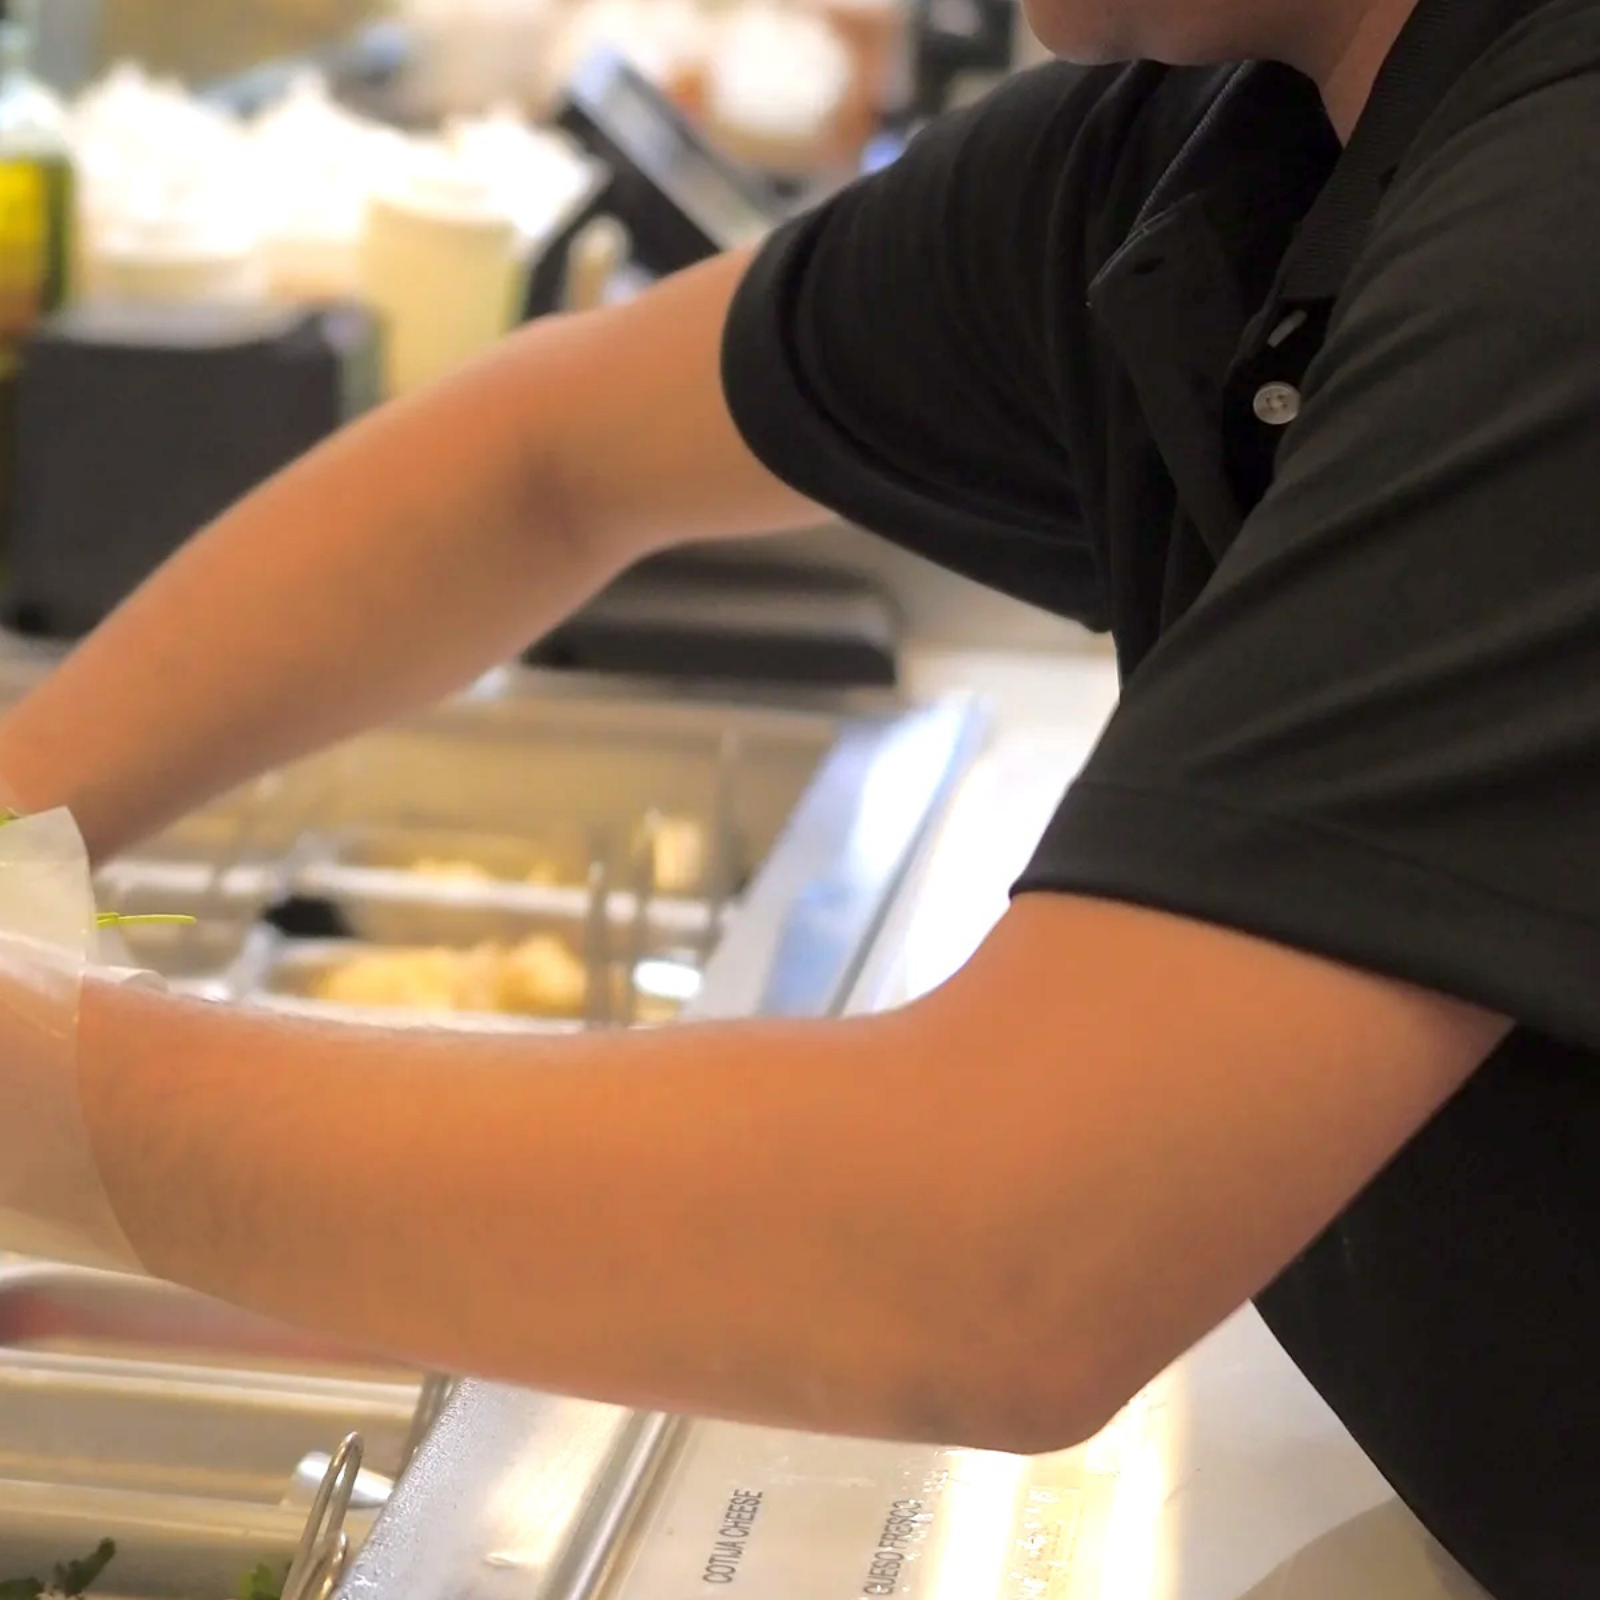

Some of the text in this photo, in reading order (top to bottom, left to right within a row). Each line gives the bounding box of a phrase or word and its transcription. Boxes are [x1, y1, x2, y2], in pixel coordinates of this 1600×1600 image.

[702, 1488, 763, 1584] COTIJA CHEESE
[863, 1499, 922, 1595] QUESO FRESCO
